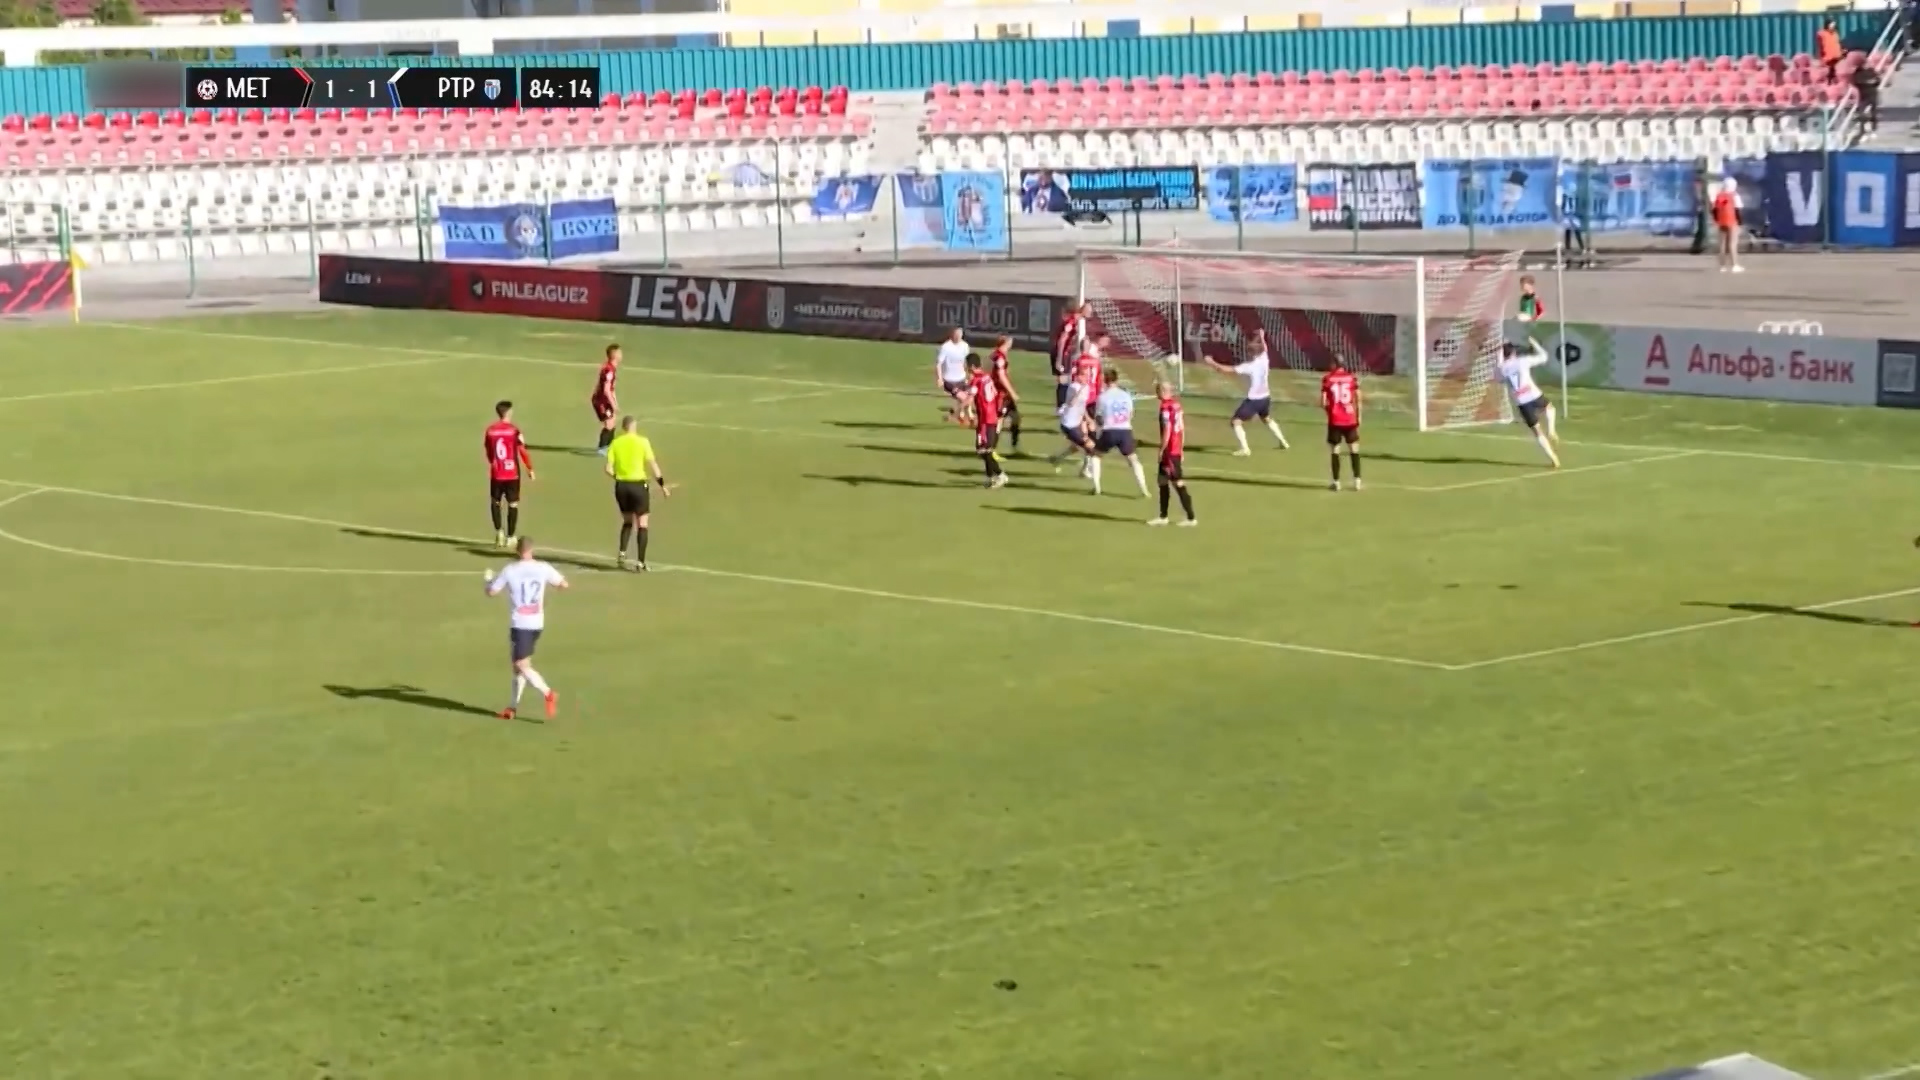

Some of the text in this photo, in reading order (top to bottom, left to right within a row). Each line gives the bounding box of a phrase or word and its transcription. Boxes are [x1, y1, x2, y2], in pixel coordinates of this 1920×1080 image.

[491, 280, 589, 304] FNLEAGUE2
[496, 437, 508, 460] 6
[520, 580, 541, 604] 12
